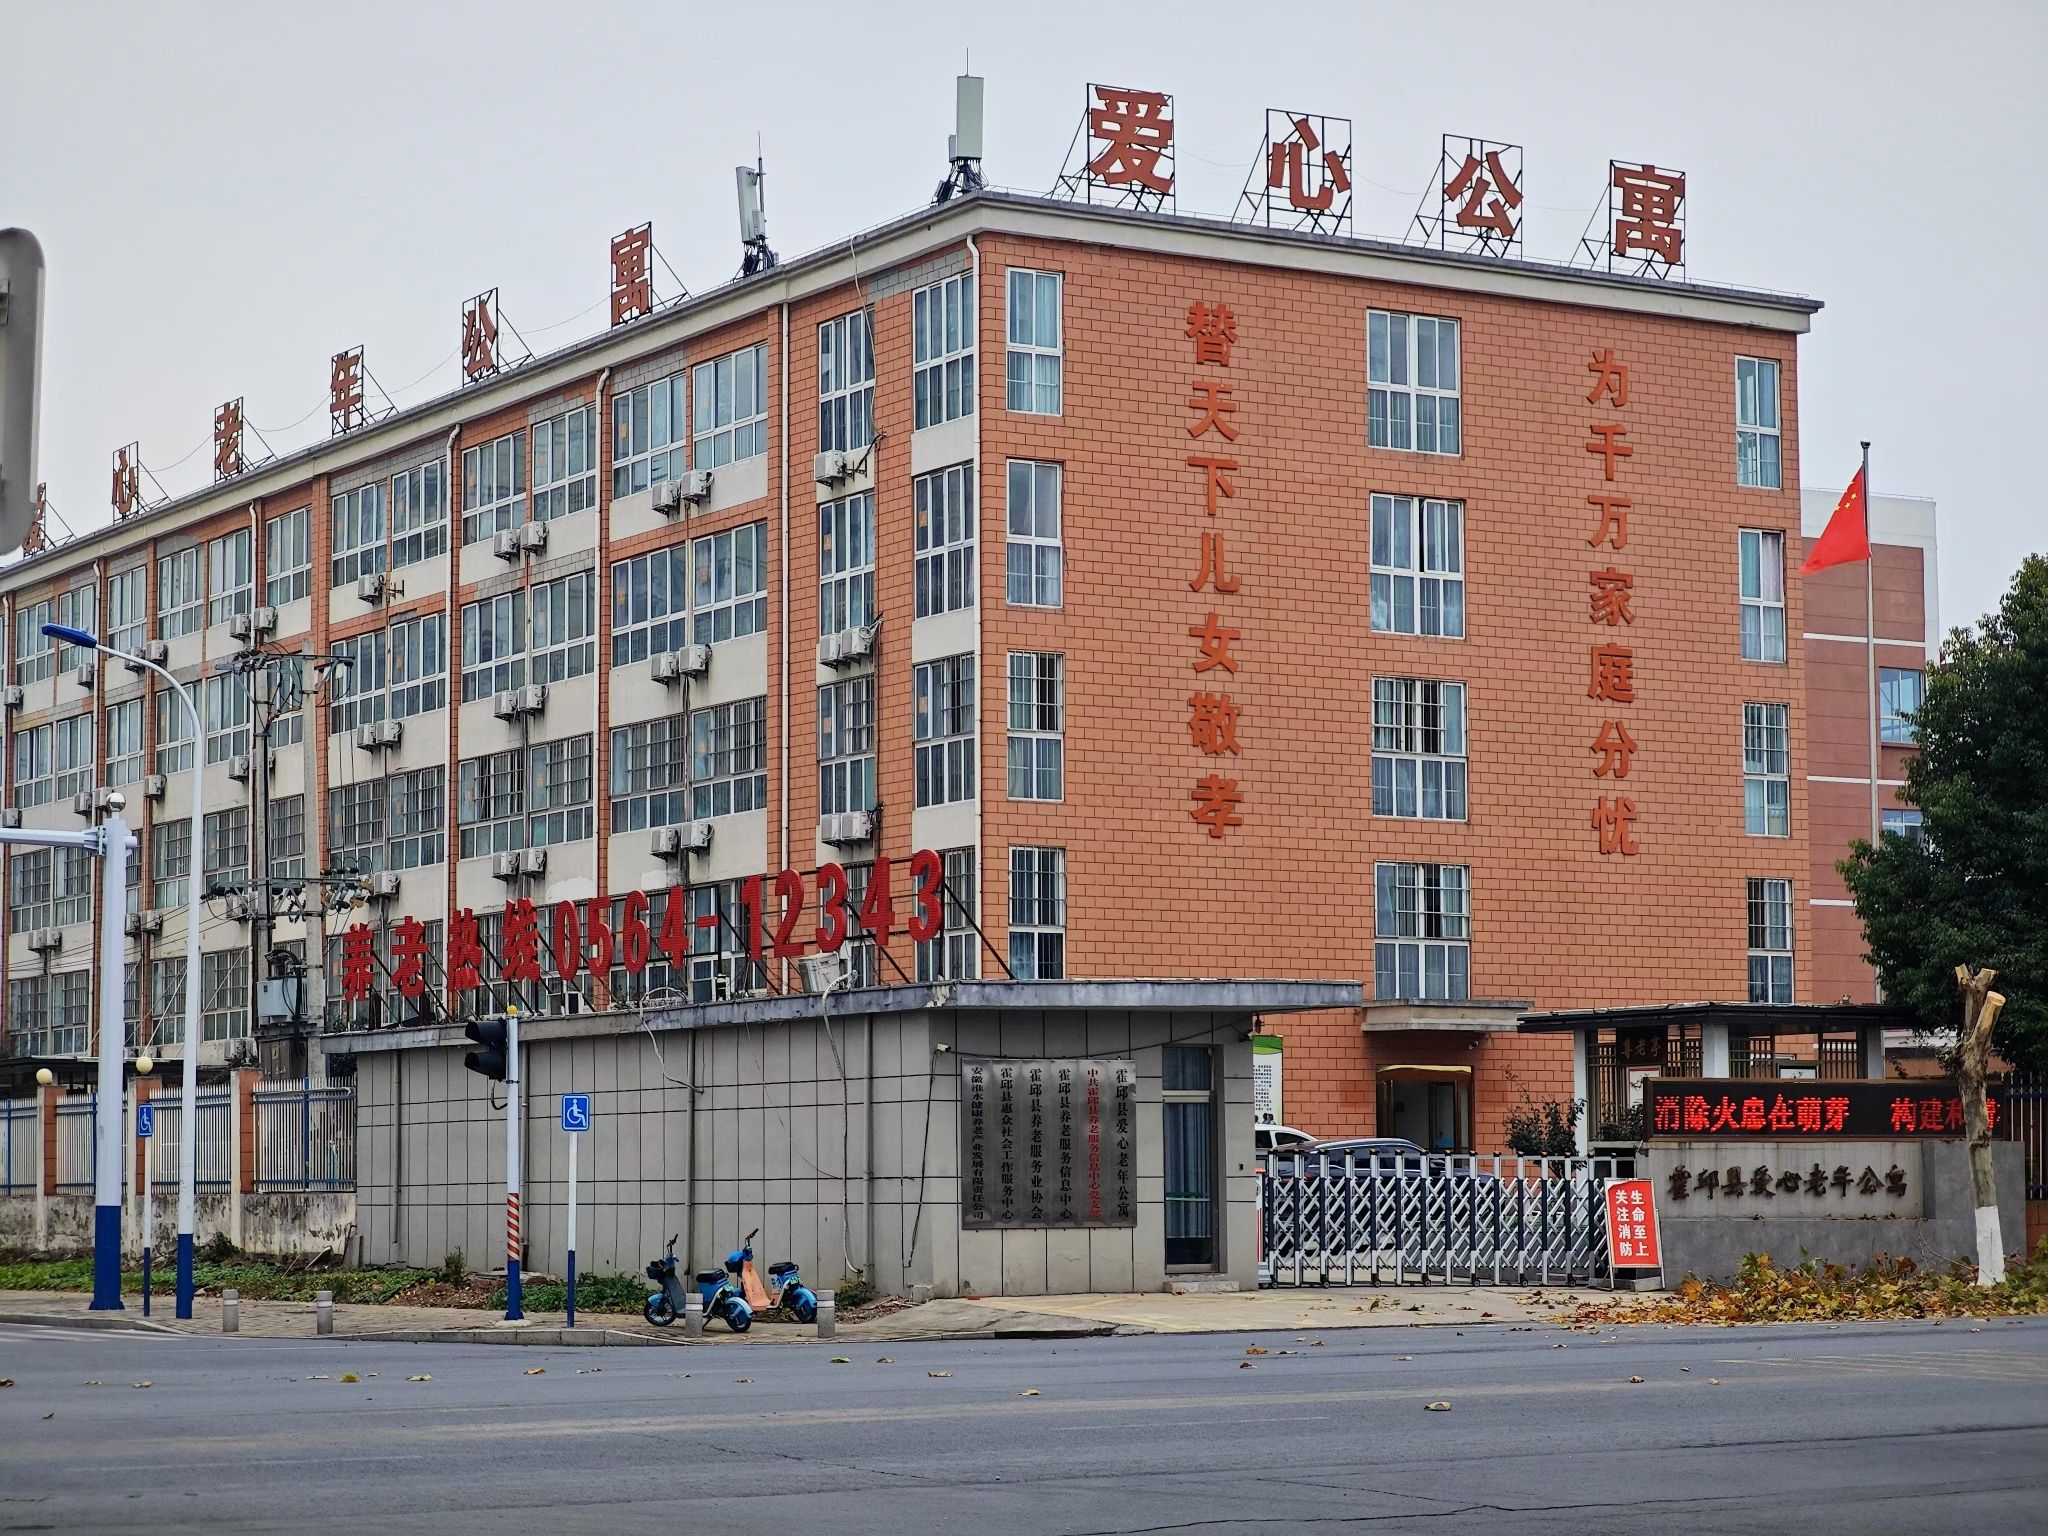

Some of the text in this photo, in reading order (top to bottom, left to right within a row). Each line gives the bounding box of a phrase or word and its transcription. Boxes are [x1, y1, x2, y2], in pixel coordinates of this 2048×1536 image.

[1090, 86, 1686, 266] 爱心公寓
[1186, 301, 1244, 838] 替天下儿女敬孝
[1586, 350, 1640, 855] 为千万家庭分忧
[341, 849, 942, 1000] 养老热线0564-12343
[1000, 1067, 1014, 1219] 霍邱县惠众社会工作服务中心
[1029, 1068, 1043, 1219] 霍邱县养老服务业协会
[1058, 1068, 1072, 1220] 霍邱县养老服务信息中心
[1115, 1069, 1130, 1218] 霍邱县爱心老年公寓
[1655, 1094, 1850, 1132] 消除火患在萌芽
[1668, 1162, 1908, 1201] 霍邱县爱心老年公寓
[1615, 1189, 1633, 1257] 关注消防
[1630, 1189, 1650, 1257] 生命至上
